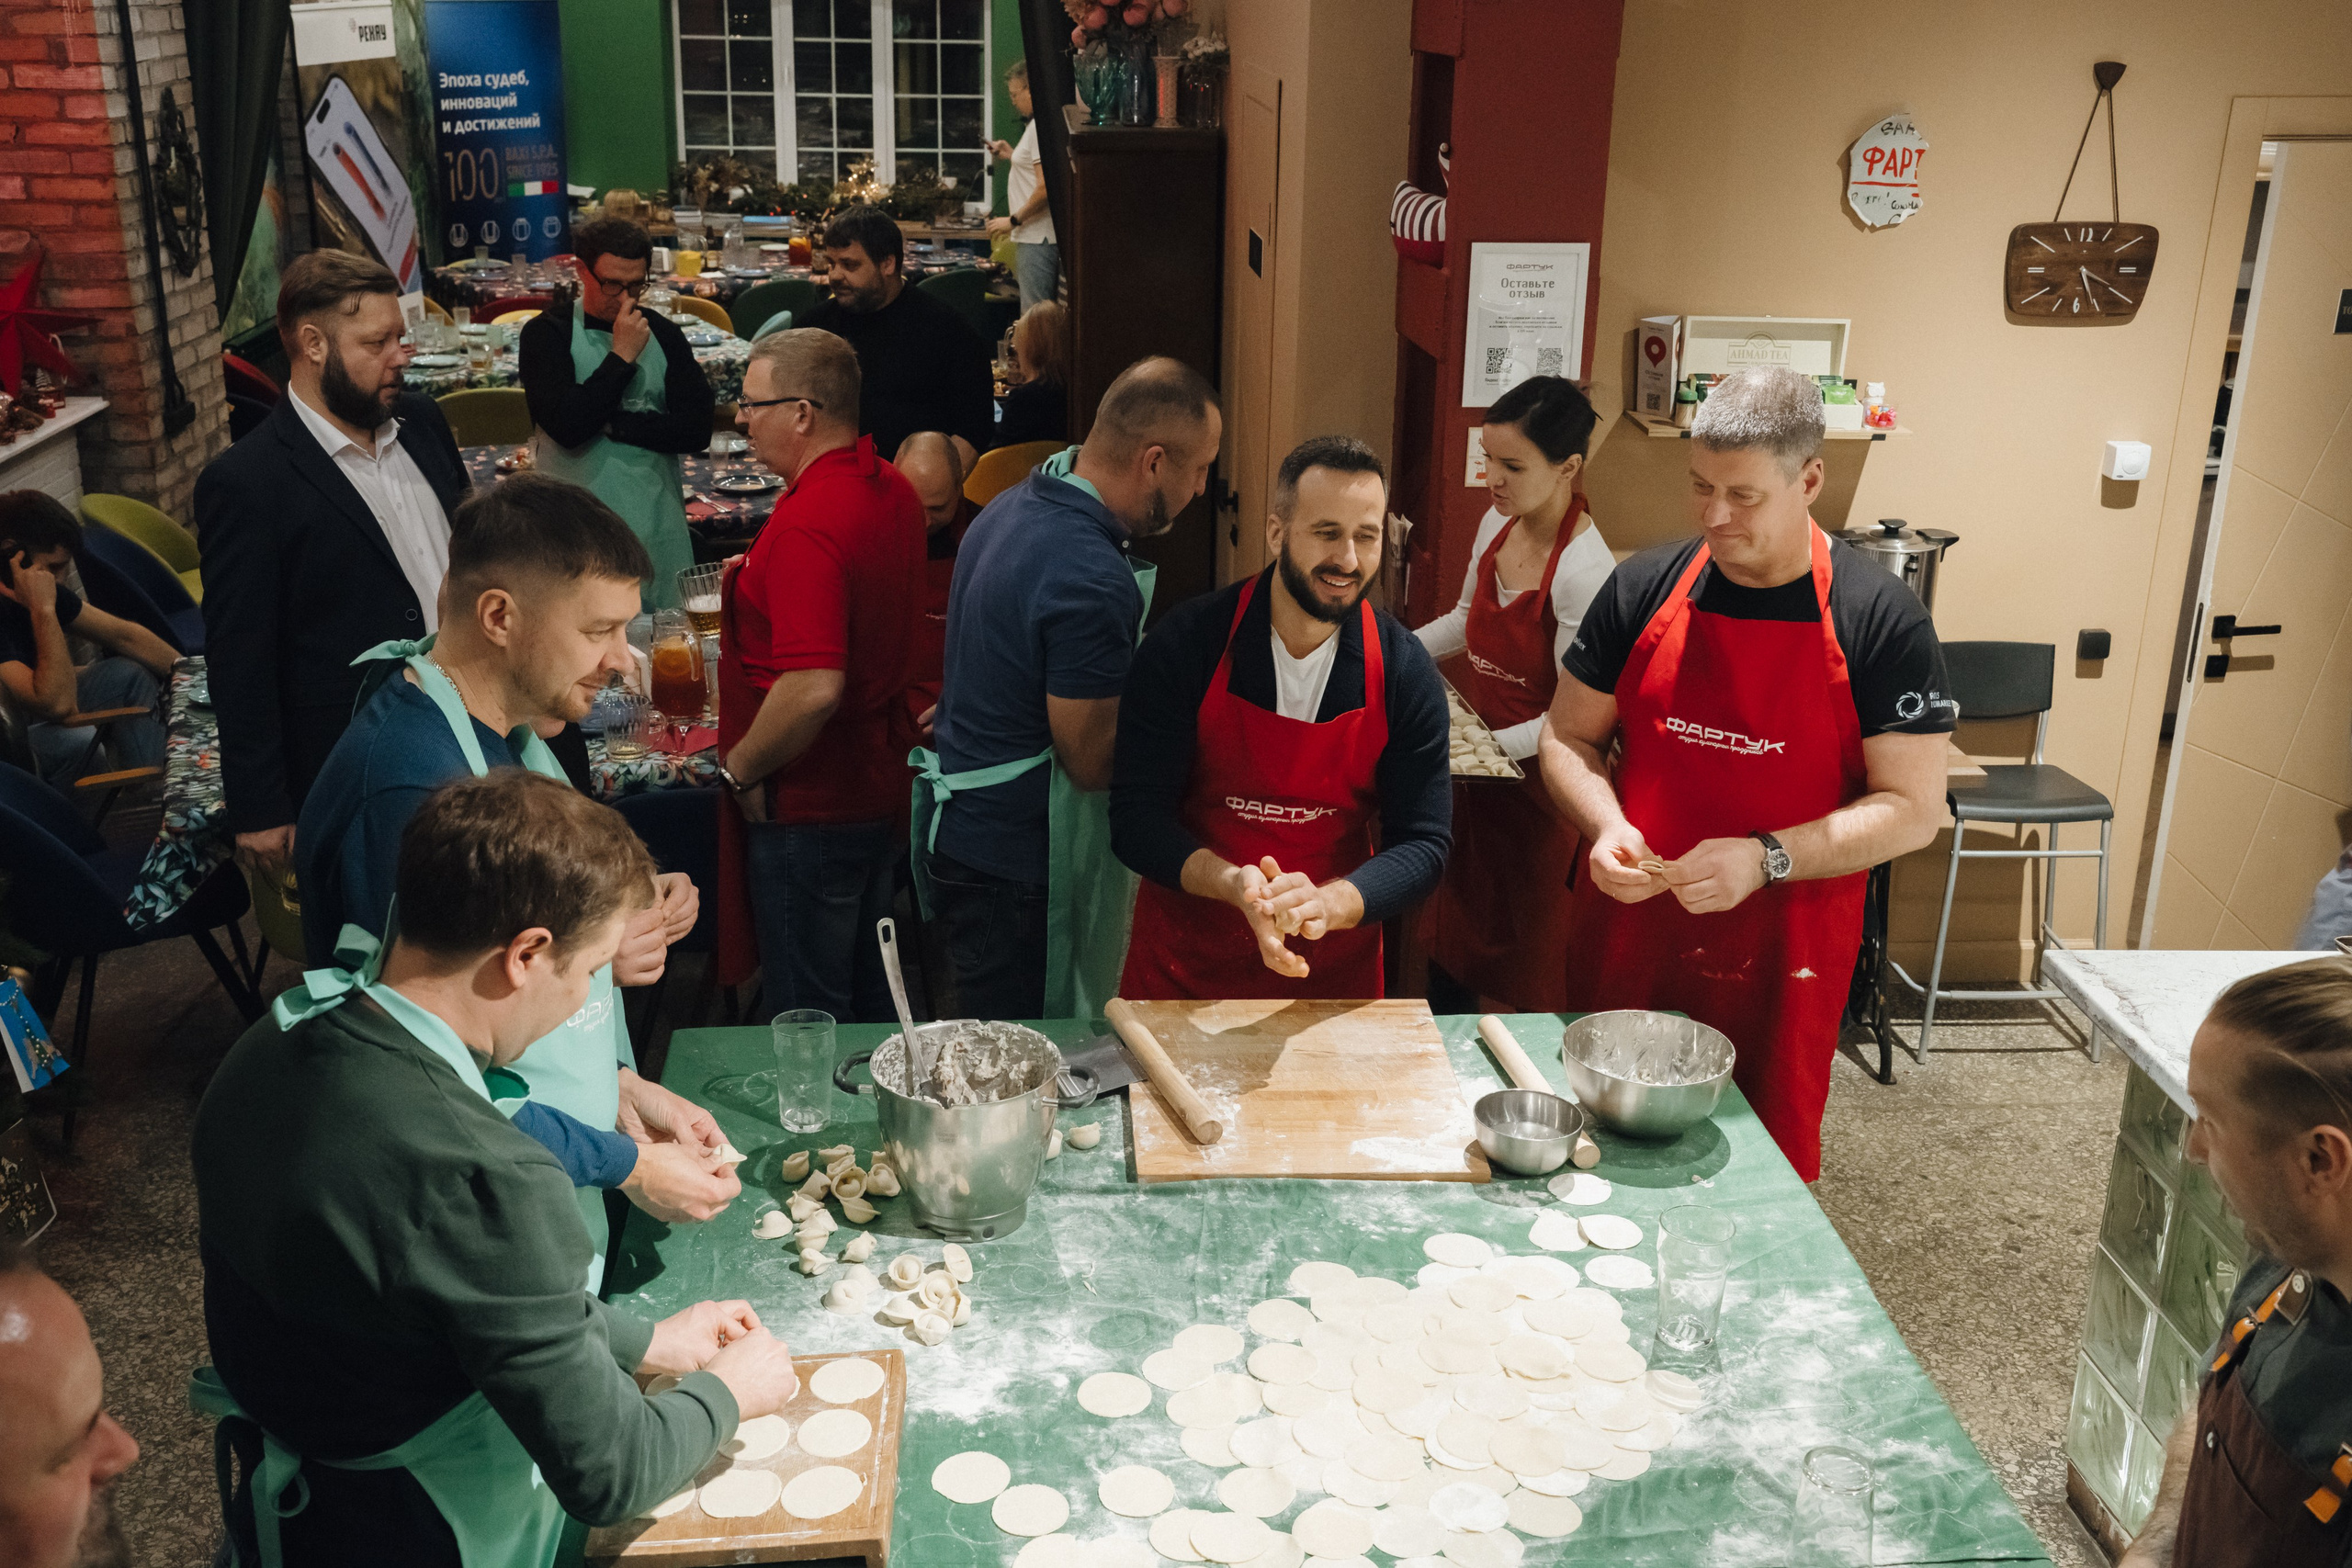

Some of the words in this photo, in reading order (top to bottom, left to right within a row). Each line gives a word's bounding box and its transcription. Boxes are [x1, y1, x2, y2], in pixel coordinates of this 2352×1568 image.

[439, 72, 481, 88] Эпоха
[484, 69, 529, 89] судеб,
[441, 91, 517, 110] инноваций
[442, 120, 451, 133] и
[454, 112, 540, 135] достижений
[444, 148, 499, 201] 100
[2079, 228, 2093, 242] 12
[1501, 277, 1555, 288] Оставьте
[1509, 289, 1545, 299] отзыв
[2073, 297, 2080, 313] 6
[1730, 349, 1768, 359] AHMAD
[1770, 350, 1788, 360] TEA
[1666, 716, 1785, 754] ФАРТУК
[1226, 795, 1338, 818] ФАРТУК
